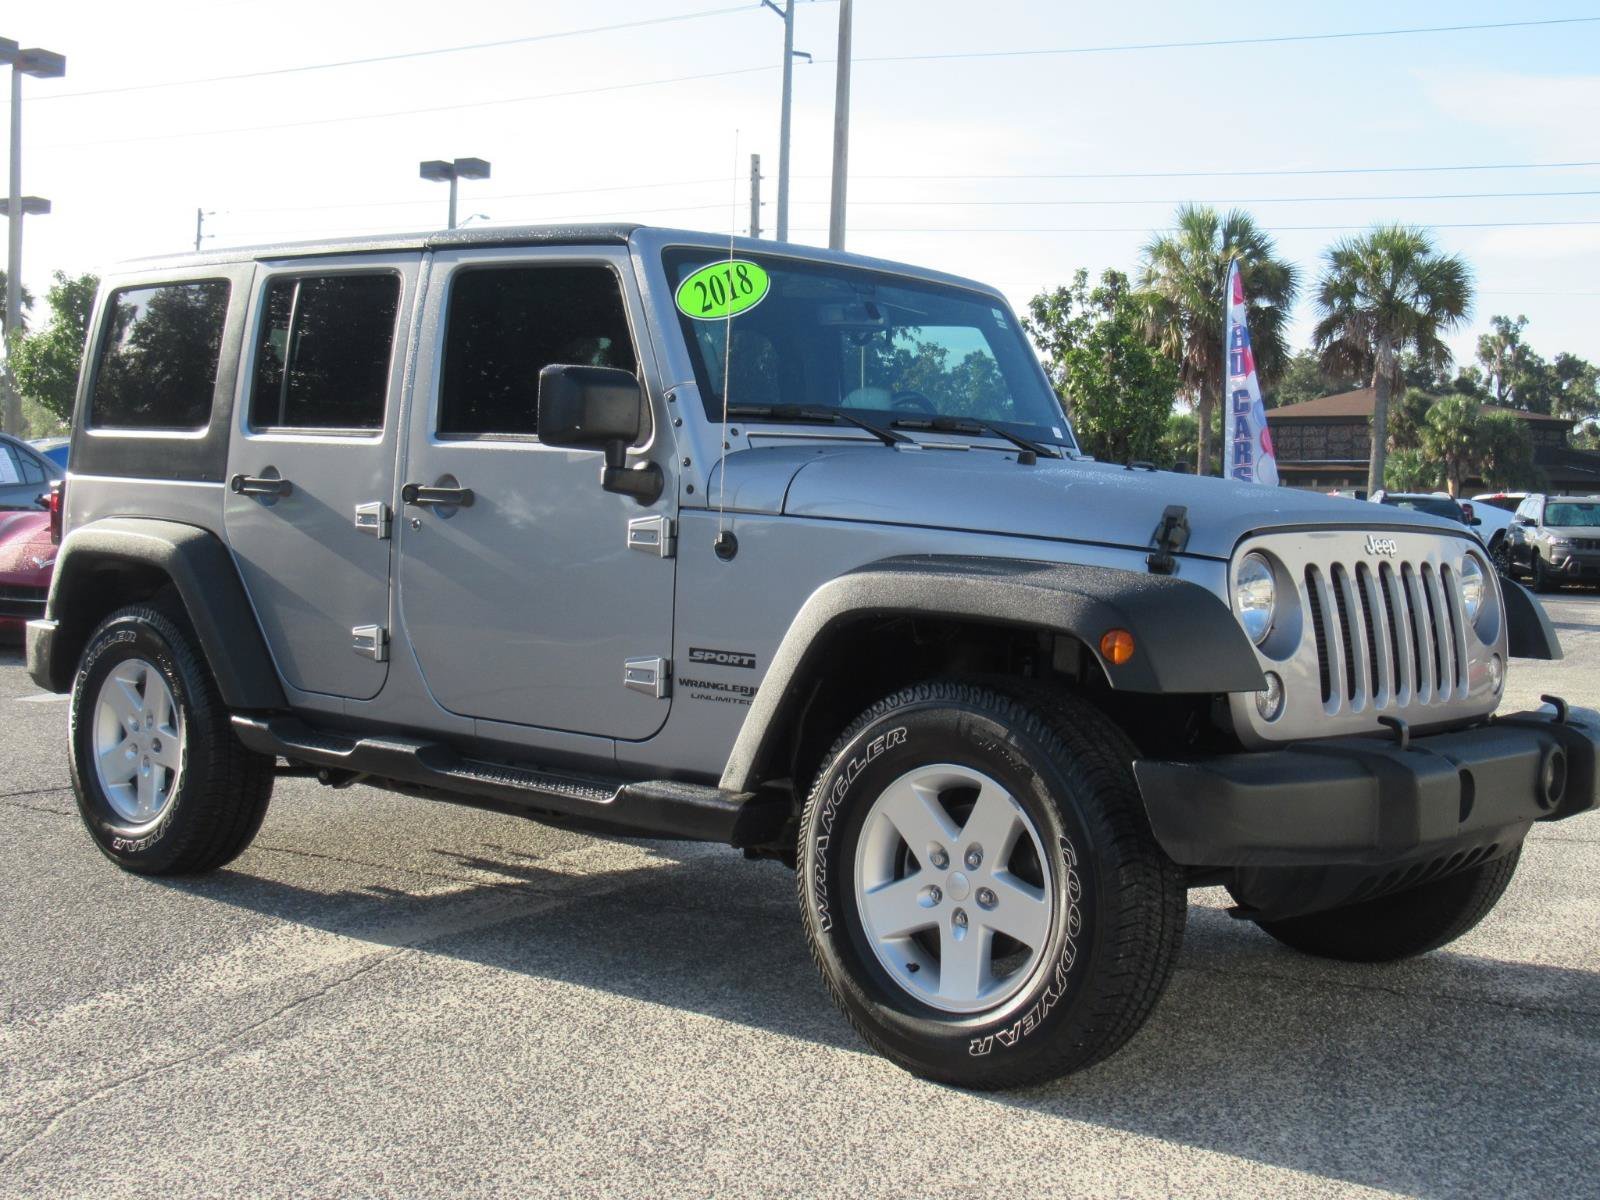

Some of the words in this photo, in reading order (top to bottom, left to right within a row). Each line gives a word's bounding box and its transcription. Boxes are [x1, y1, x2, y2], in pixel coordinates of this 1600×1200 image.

[693, 264, 753, 313] 2018
[1365, 534, 1397, 559] Jeep
[688, 650, 756, 666] SPORT
[812, 726, 908, 933] WRANGLER
[968, 834, 1082, 1057] GOODYEAR
